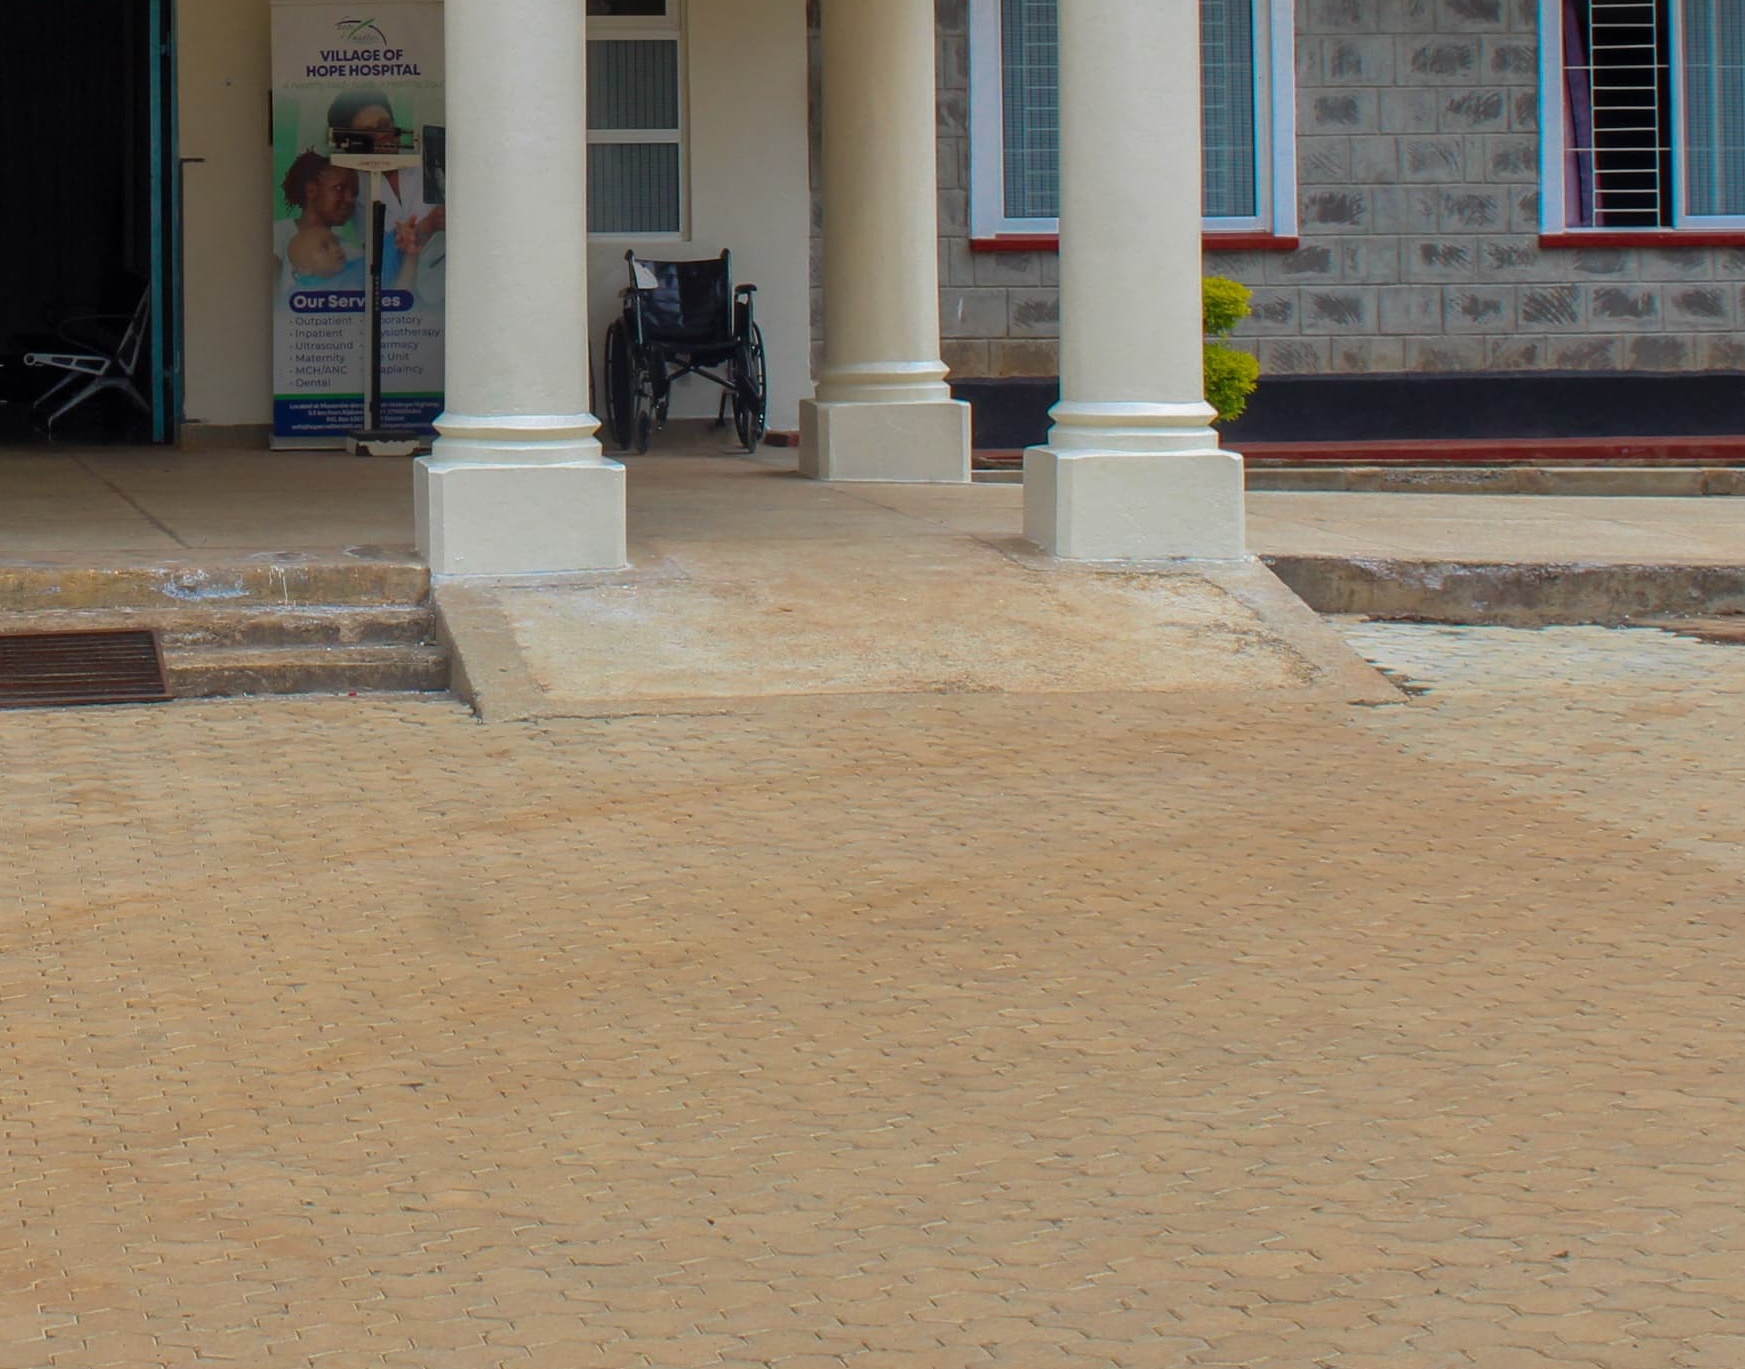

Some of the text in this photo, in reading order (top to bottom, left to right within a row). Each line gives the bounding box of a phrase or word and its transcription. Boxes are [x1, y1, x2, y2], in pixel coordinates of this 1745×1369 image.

[320, 49, 403, 62] VILLAGE OF
[306, 64, 421, 77] HOPE HOSPITAL
[293, 294, 401, 308] Our Serves
[295, 316, 352, 327] Outpatient
[295, 329, 343, 339] Inpatient
[381, 328, 441, 338] ysiotherapy
[295, 341, 353, 350] Ultrasound
[295, 353, 346, 364] Maternity
[387, 351, 410, 361] Unit
[295, 365, 348, 375] MCH/ANC
[295, 378, 331, 388] Dental
